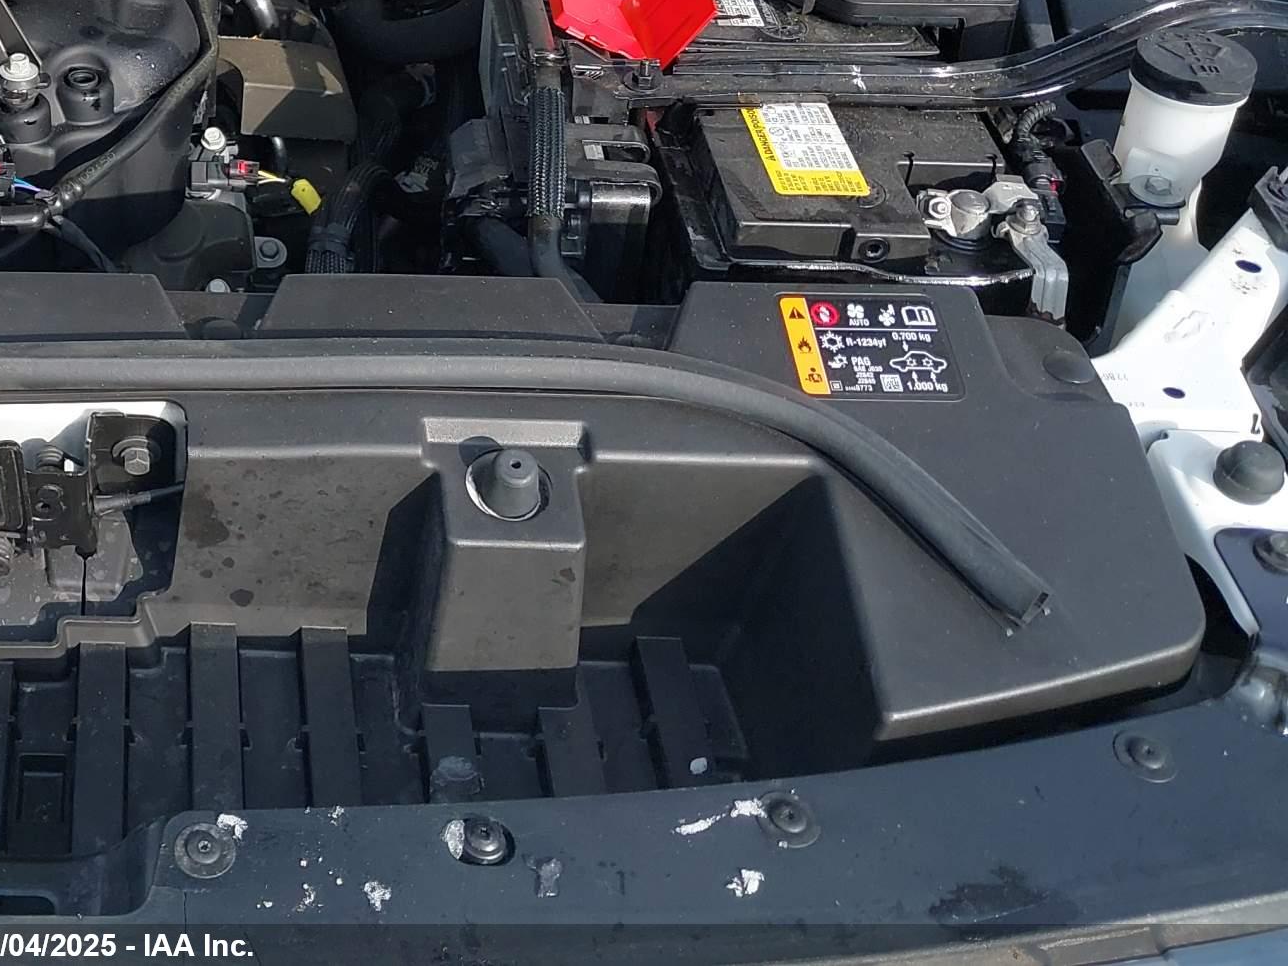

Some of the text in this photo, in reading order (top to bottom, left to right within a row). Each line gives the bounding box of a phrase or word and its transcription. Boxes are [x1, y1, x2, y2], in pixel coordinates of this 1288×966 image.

[849, 318, 870, 326] AUTO
[845, 337, 887, 348] R-1234yf
[891, 332, 932, 343] 0.700 kg
[851, 356, 871, 366] PAG
[907, 382, 949, 393] 1.000 kg
